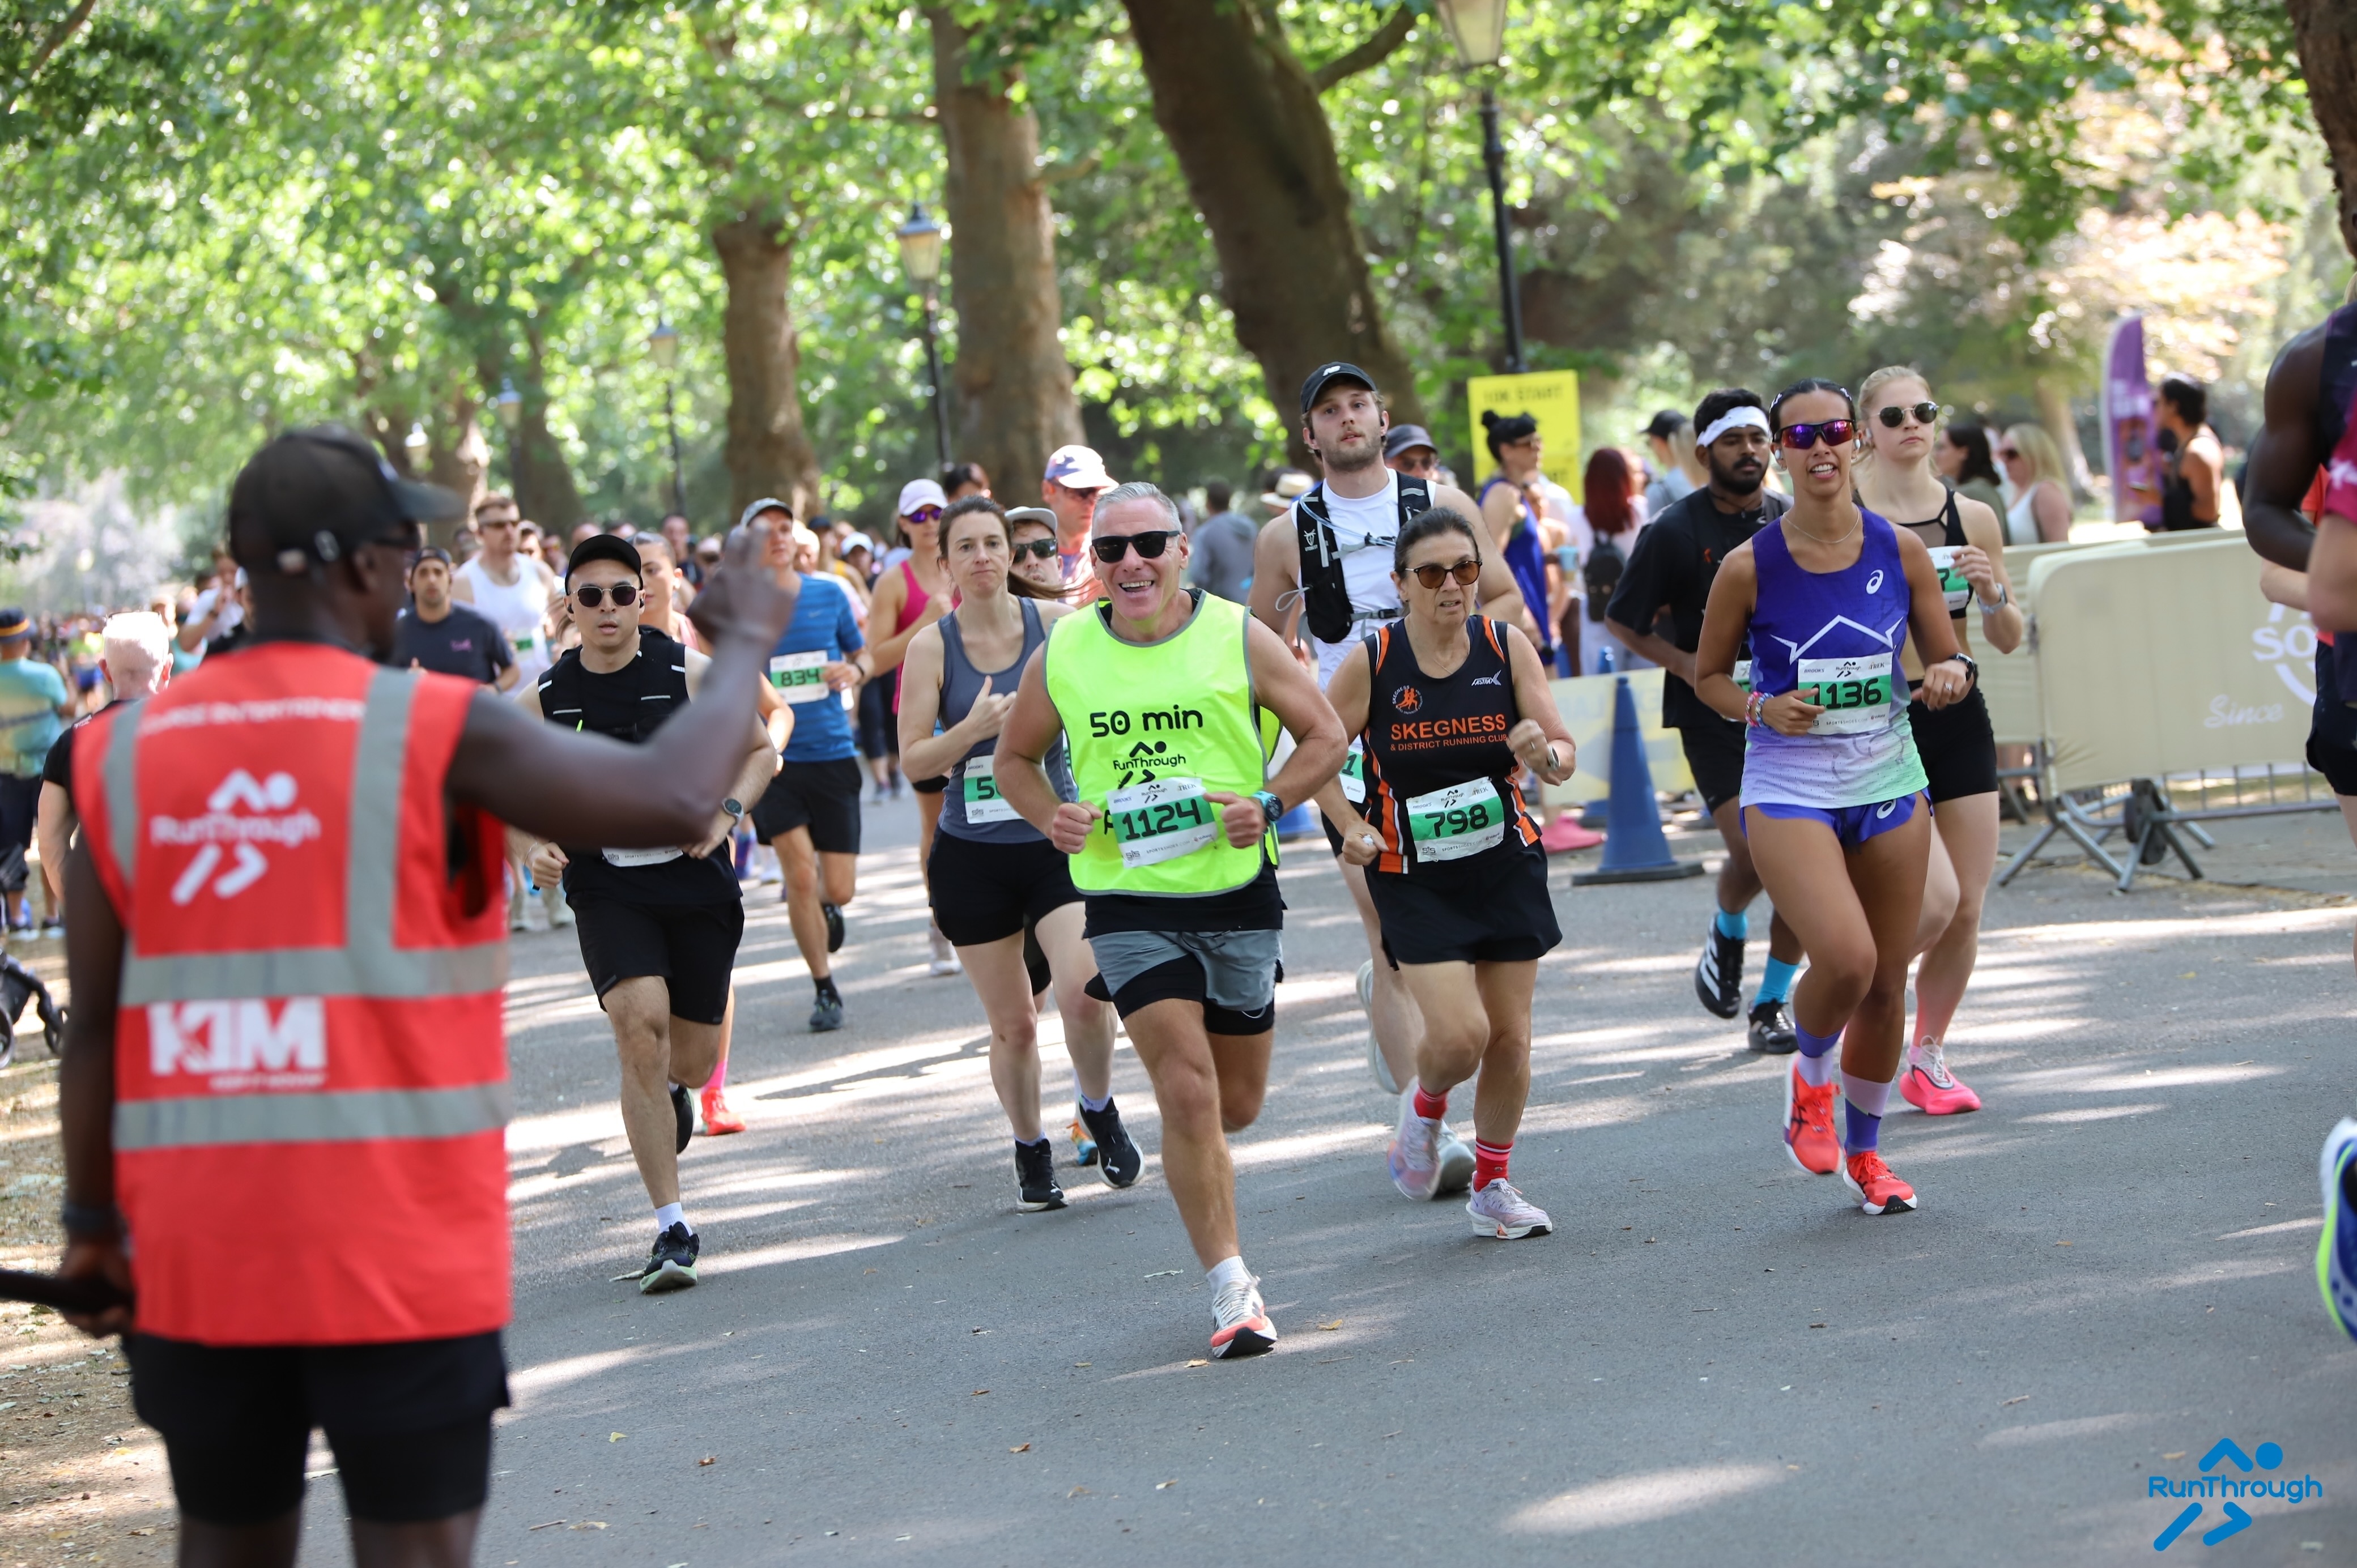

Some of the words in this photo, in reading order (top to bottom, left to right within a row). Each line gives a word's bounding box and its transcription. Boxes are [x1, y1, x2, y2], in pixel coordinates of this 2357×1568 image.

[781, 667, 820, 687] 834
[1811, 678, 1882, 709] 1136
[1090, 710, 1130, 737] 50
[1142, 704, 1203, 731] min
[2204, 694, 2283, 728] Since
[1391, 714, 1506, 740] SKEGNESS
[1398, 740, 1440, 751] DISTRICT
[1443, 736, 1486, 747] RUNNING
[1488, 734, 1508, 743] CLUB
[1112, 753, 1186, 770] RunThrough
[1122, 798, 1202, 840] 1124
[1424, 804, 1489, 837] 798
